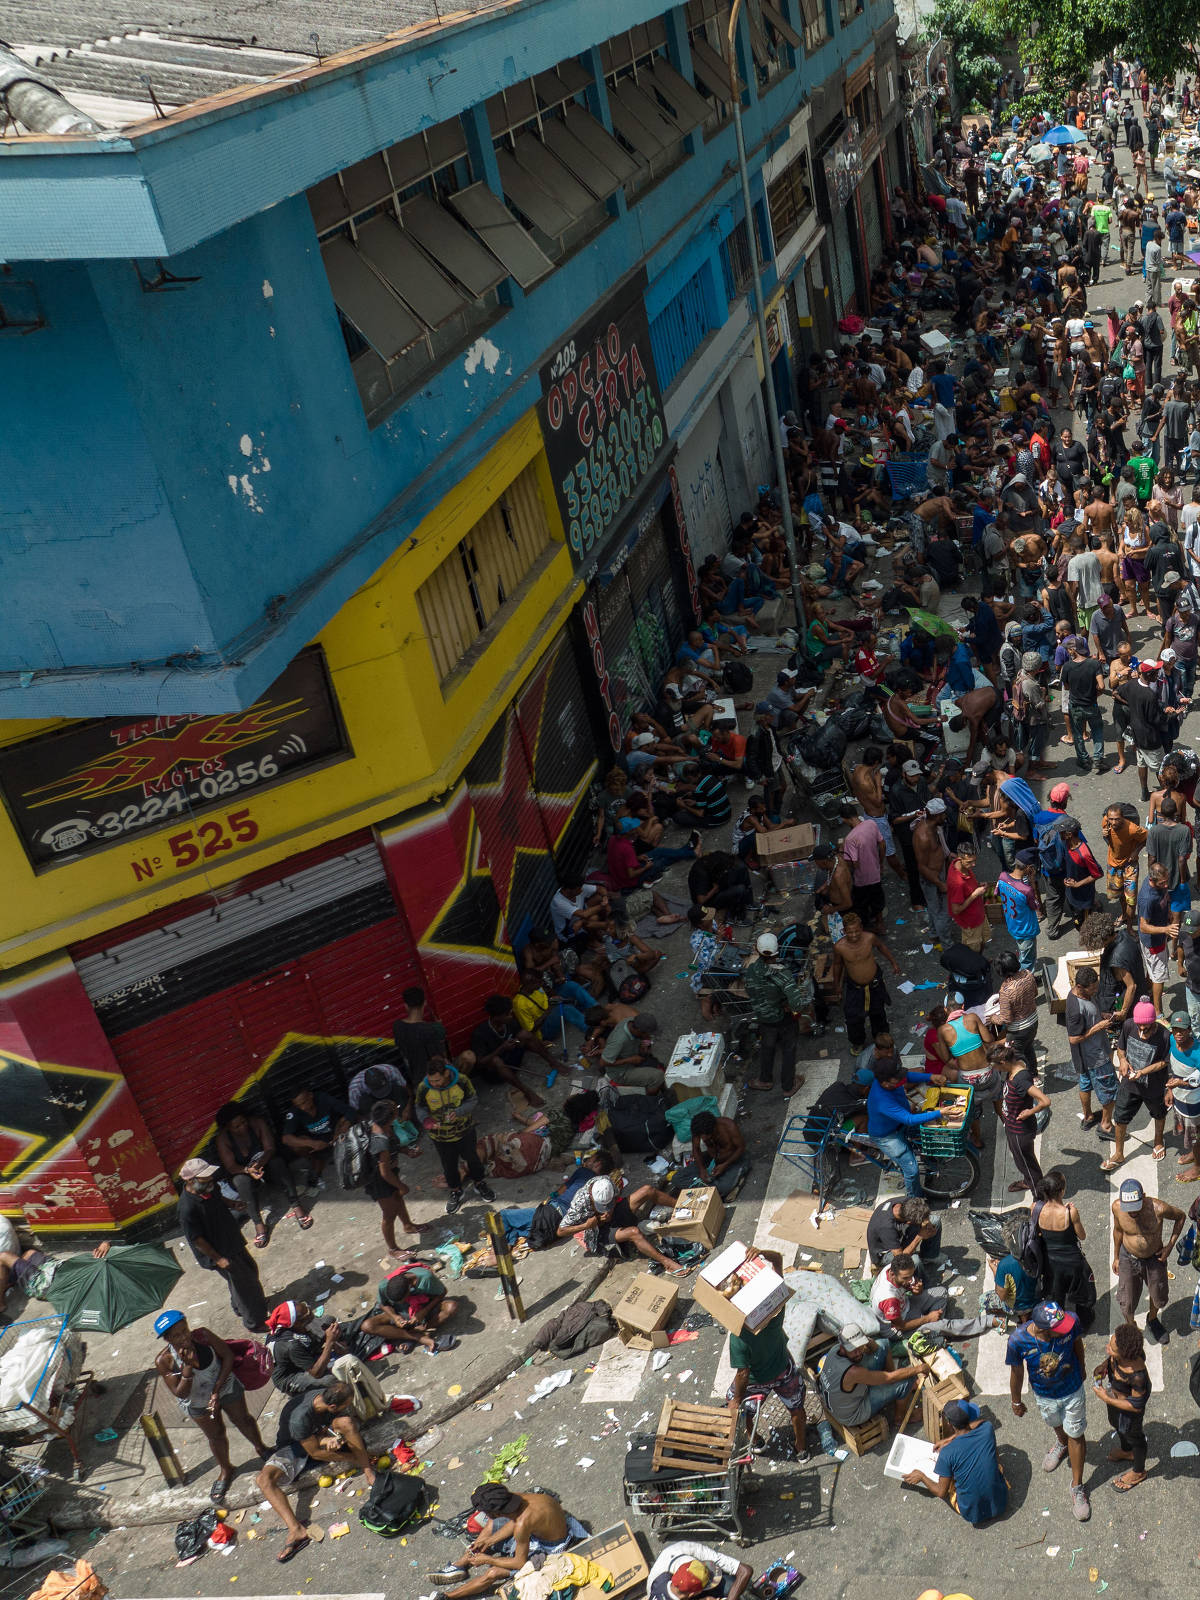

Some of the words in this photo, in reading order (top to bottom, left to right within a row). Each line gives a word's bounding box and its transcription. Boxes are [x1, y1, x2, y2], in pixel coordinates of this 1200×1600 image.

[556, 340, 576, 375] 208
[578, 343, 646, 447] CERTA
[583, 600, 622, 753] MOTO
[97, 754, 279, 838] 3224-0256
[142, 755, 227, 799] MOTOS
[167, 808, 260, 869] 525
